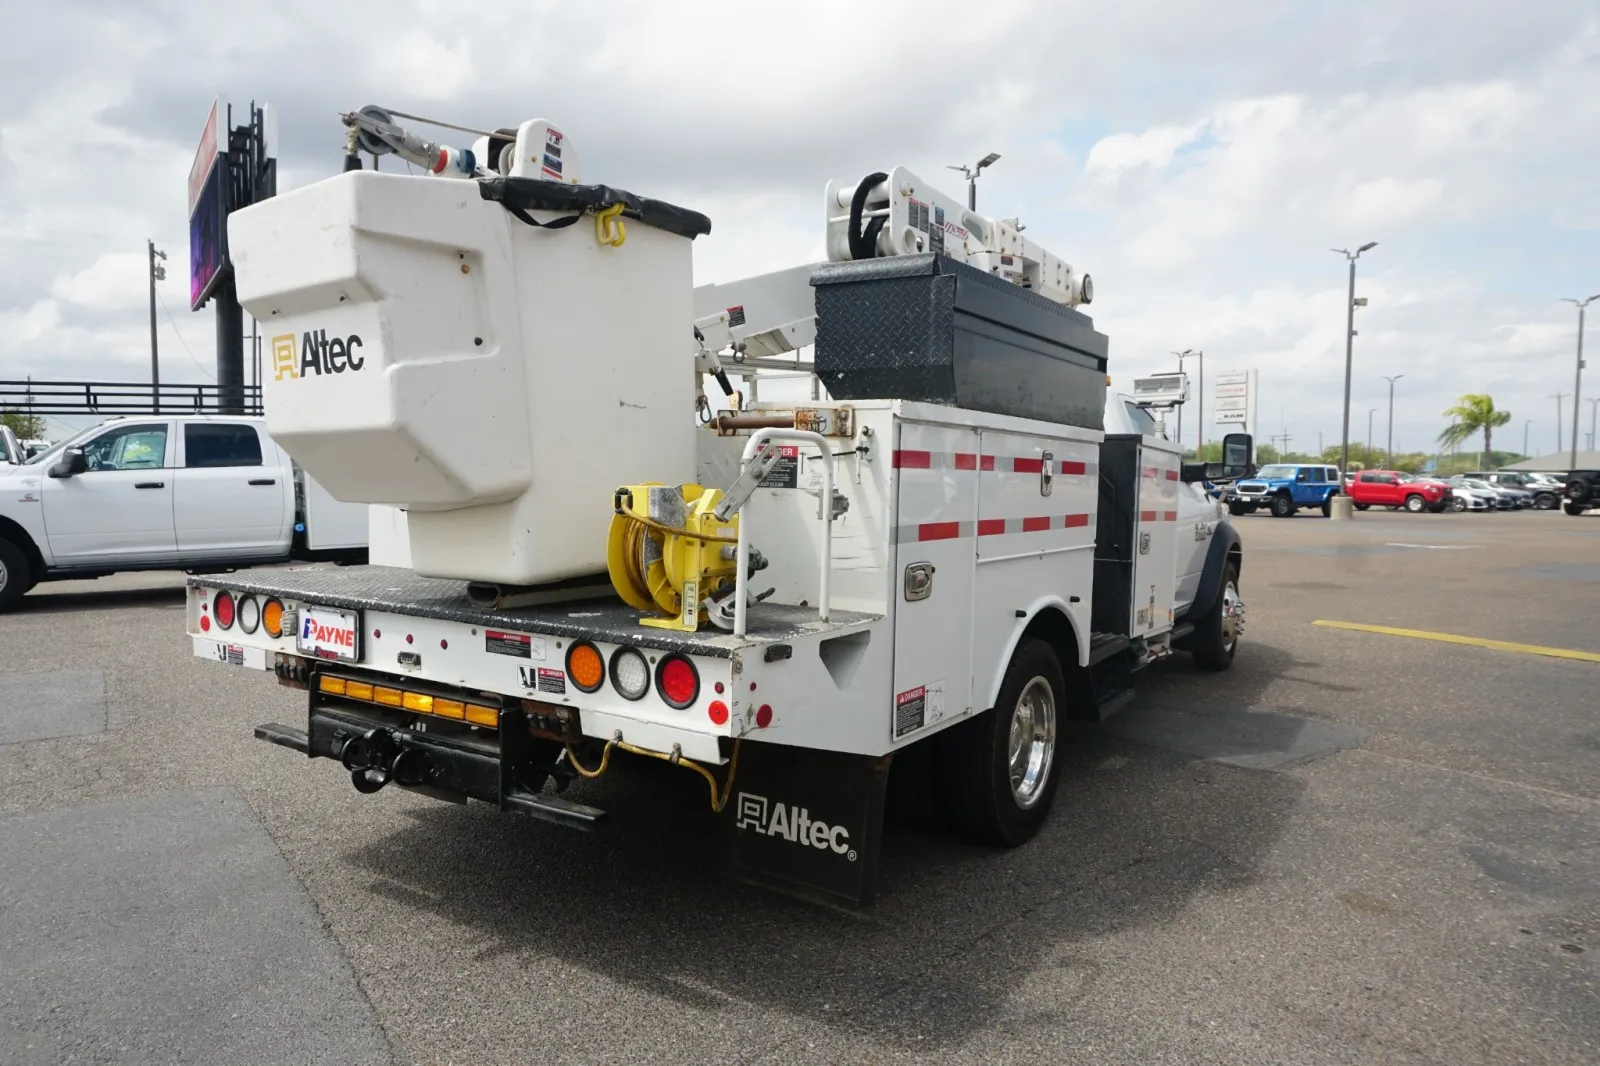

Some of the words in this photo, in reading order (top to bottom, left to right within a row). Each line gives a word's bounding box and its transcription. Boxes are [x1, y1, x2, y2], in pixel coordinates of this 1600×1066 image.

[300, 328, 364, 377] Altec
[302, 616, 355, 647] PAYNE
[904, 688, 923, 701] DANGER
[767, 802, 849, 854] Altec
